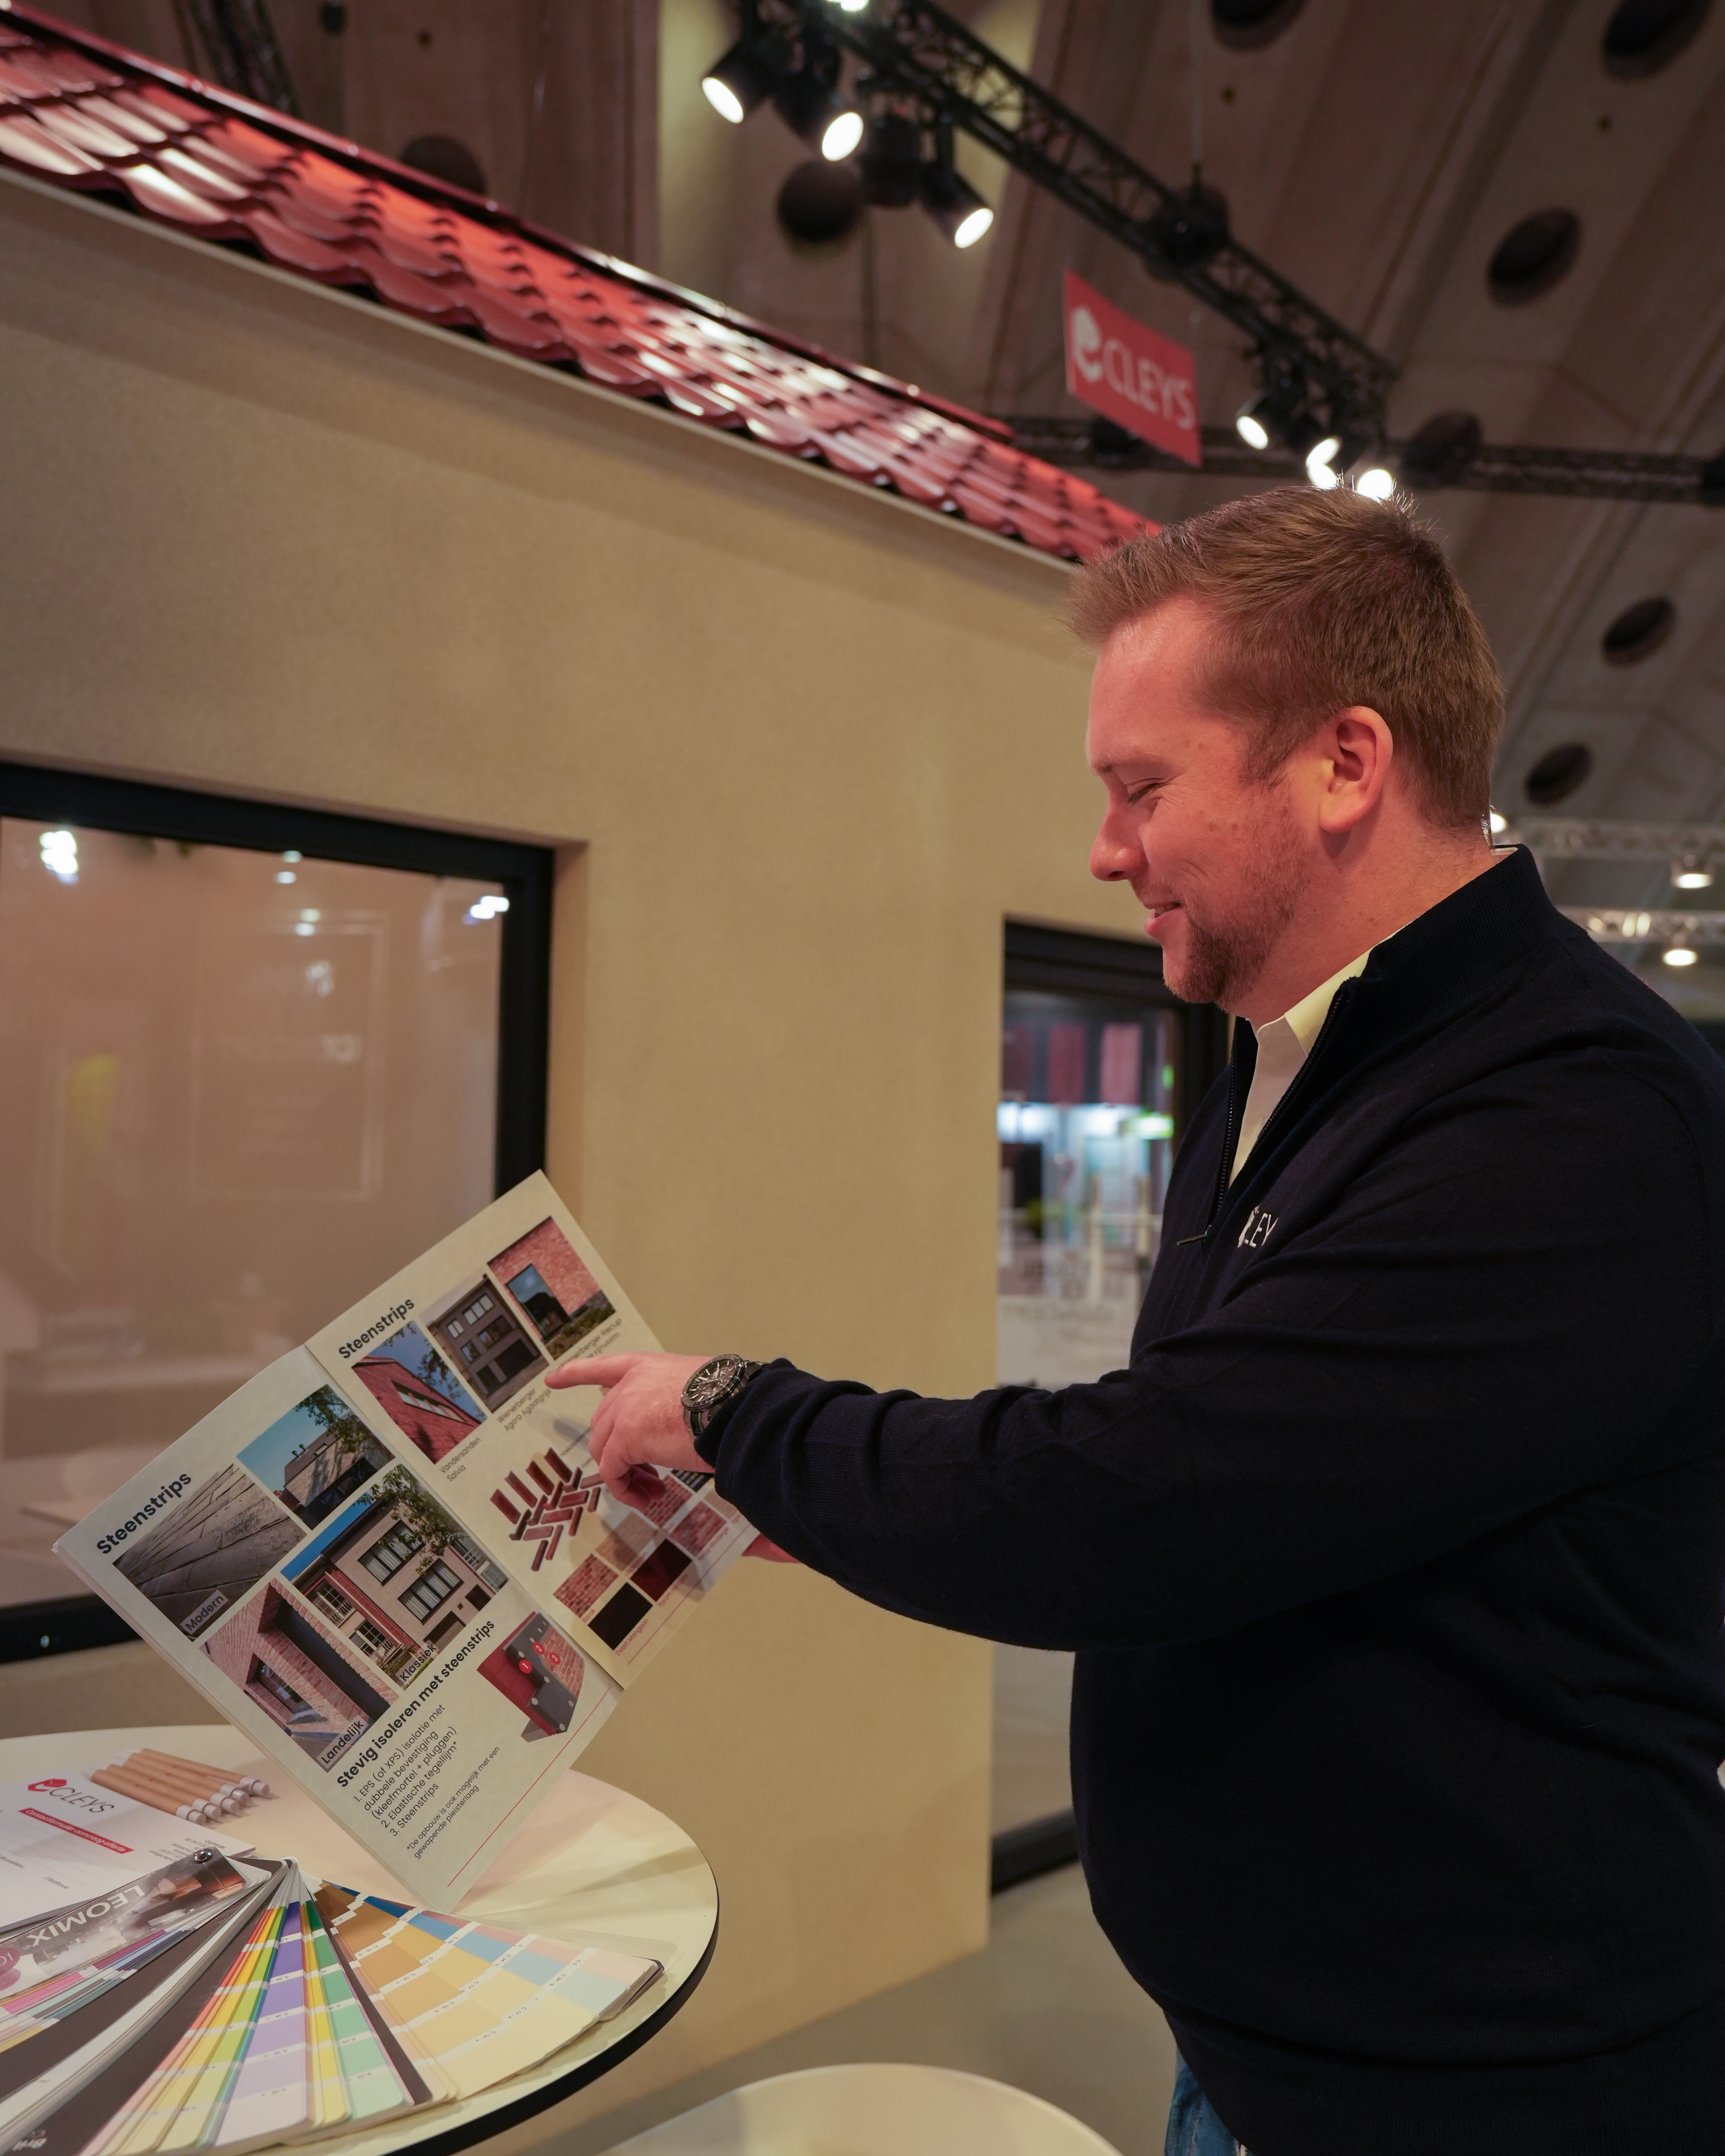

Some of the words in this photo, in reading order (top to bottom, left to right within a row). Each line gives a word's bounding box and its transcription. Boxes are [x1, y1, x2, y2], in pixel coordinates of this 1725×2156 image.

[1102, 338, 1196, 430] CLEYS
[339, 1300, 414, 1358] Steenstrips
[497, 1388, 536, 1423] Wienerberger
[504, 1414, 522, 1431] Agora
[440, 1438, 481, 1473] Vandersanden
[447, 1465, 466, 1481] Salvia
[97, 1474, 191, 1554] Steenstrips
[185, 1596, 224, 1631] Modern
[399, 1644, 437, 1681] Klassiek
[337, 1747, 378, 1787] Stevig
[372, 1700, 421, 1749] isoleren
[418, 1675, 443, 1702] met
[441, 1621, 494, 1677] steenstrips
[322, 1721, 364, 1764] Landelijk
[359, 1781, 375, 1796] EPS
[373, 1767, 386, 1781] (of
[385, 1748, 404, 1769] XPS)
[402, 1722, 429, 1750] isolatie
[429, 1705, 445, 1722] met
[364, 1777, 395, 1810] dubbele
[393, 1731, 438, 1777] bevestiging
[371, 1769, 418, 1819] (kleefmortel
[423, 1726, 456, 1766] pluggen)
[418, 1814, 440, 1839] opbouw
[446, 1796, 457, 1808] ook
[456, 1770, 479, 1796] mogelijk
[478, 1758, 490, 1771] met
[489, 1747, 500, 1758] een
[49, 1788, 114, 1813] CLEYS
[388, 1780, 425, 1820] Elastische
[397, 1783, 439, 1828] Steenstrips
[415, 1821, 447, 1859] gewapende
[446, 1785, 479, 1823] pleisterlaag
